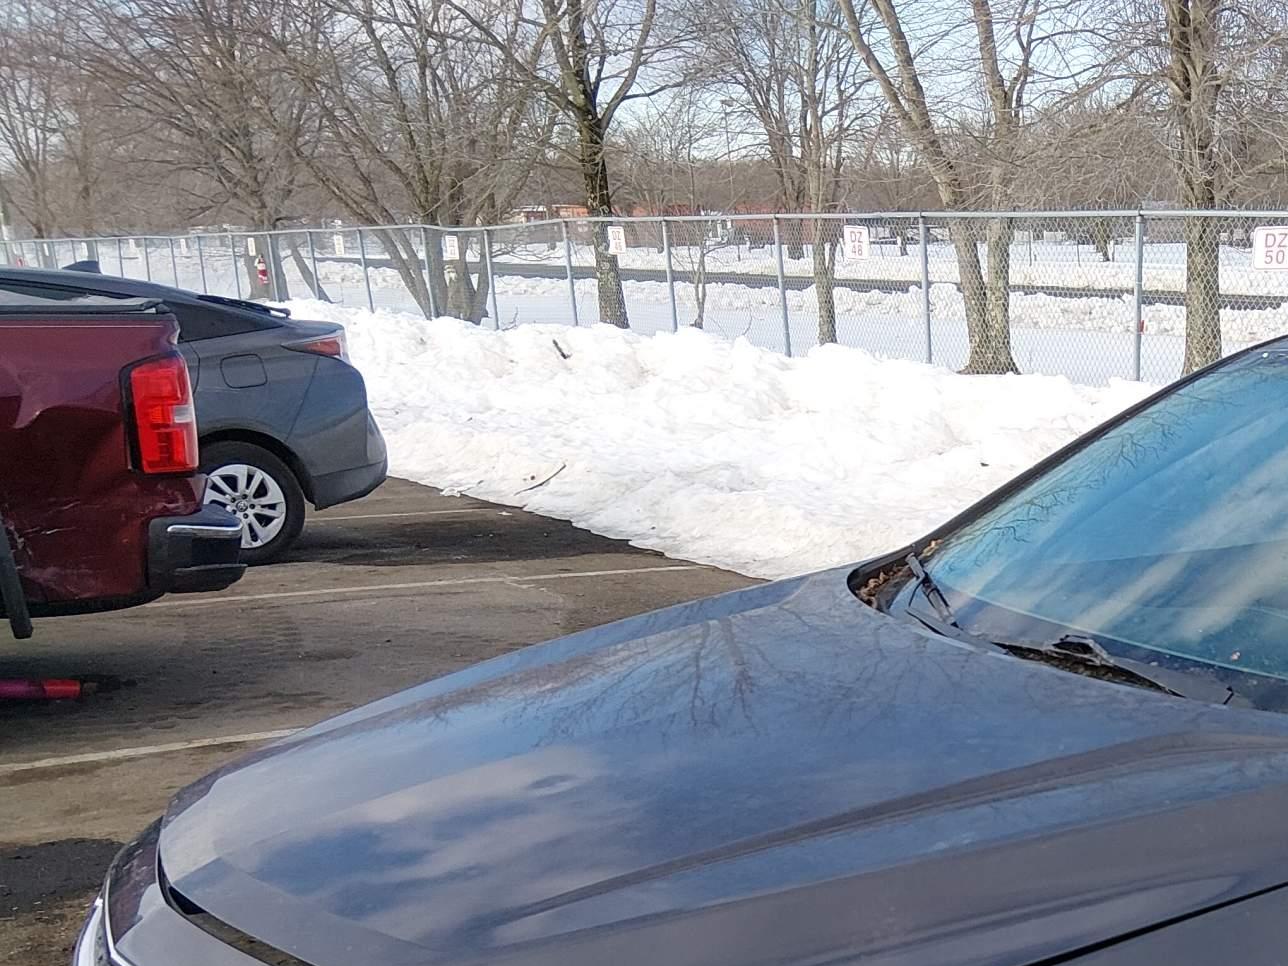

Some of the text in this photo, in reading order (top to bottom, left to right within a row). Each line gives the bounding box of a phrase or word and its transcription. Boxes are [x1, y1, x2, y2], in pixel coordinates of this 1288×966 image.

[850, 231, 863, 243] DZ
[1265, 233, 1288, 248] DZ
[851, 244, 863, 256] 48
[1264, 250, 1285, 264] 50
